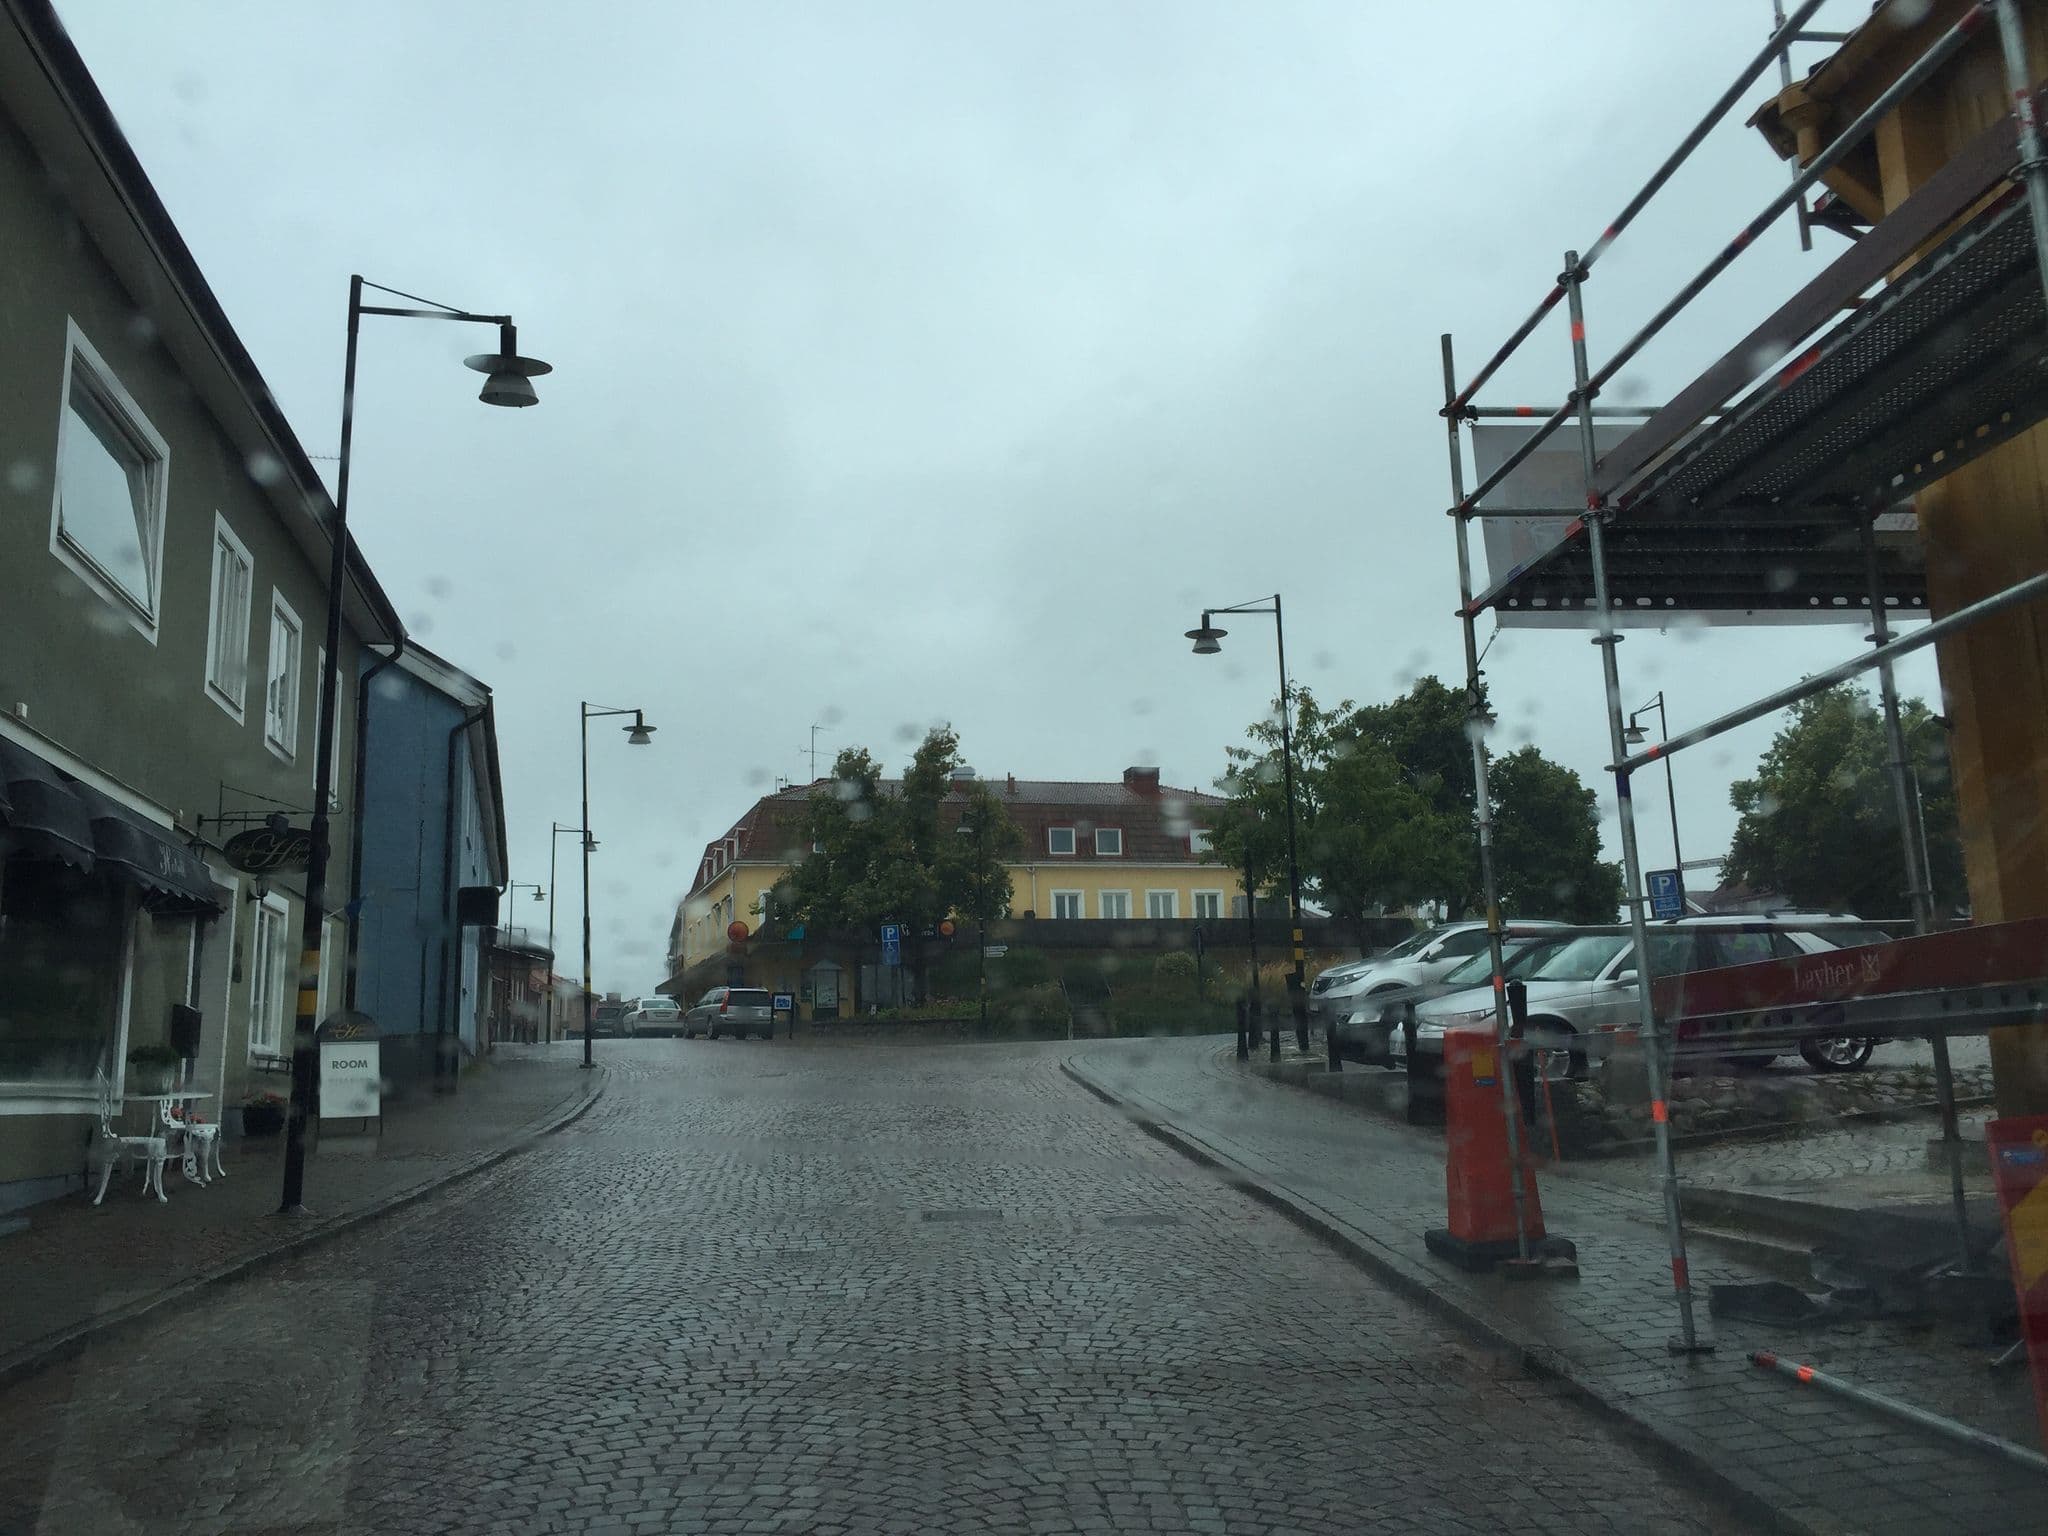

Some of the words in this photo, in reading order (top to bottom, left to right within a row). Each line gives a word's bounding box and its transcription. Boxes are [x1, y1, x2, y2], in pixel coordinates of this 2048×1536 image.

[1658, 876, 1671, 896] P
[886, 927, 896, 940] P
[331, 1059, 369, 1070] ROOM
